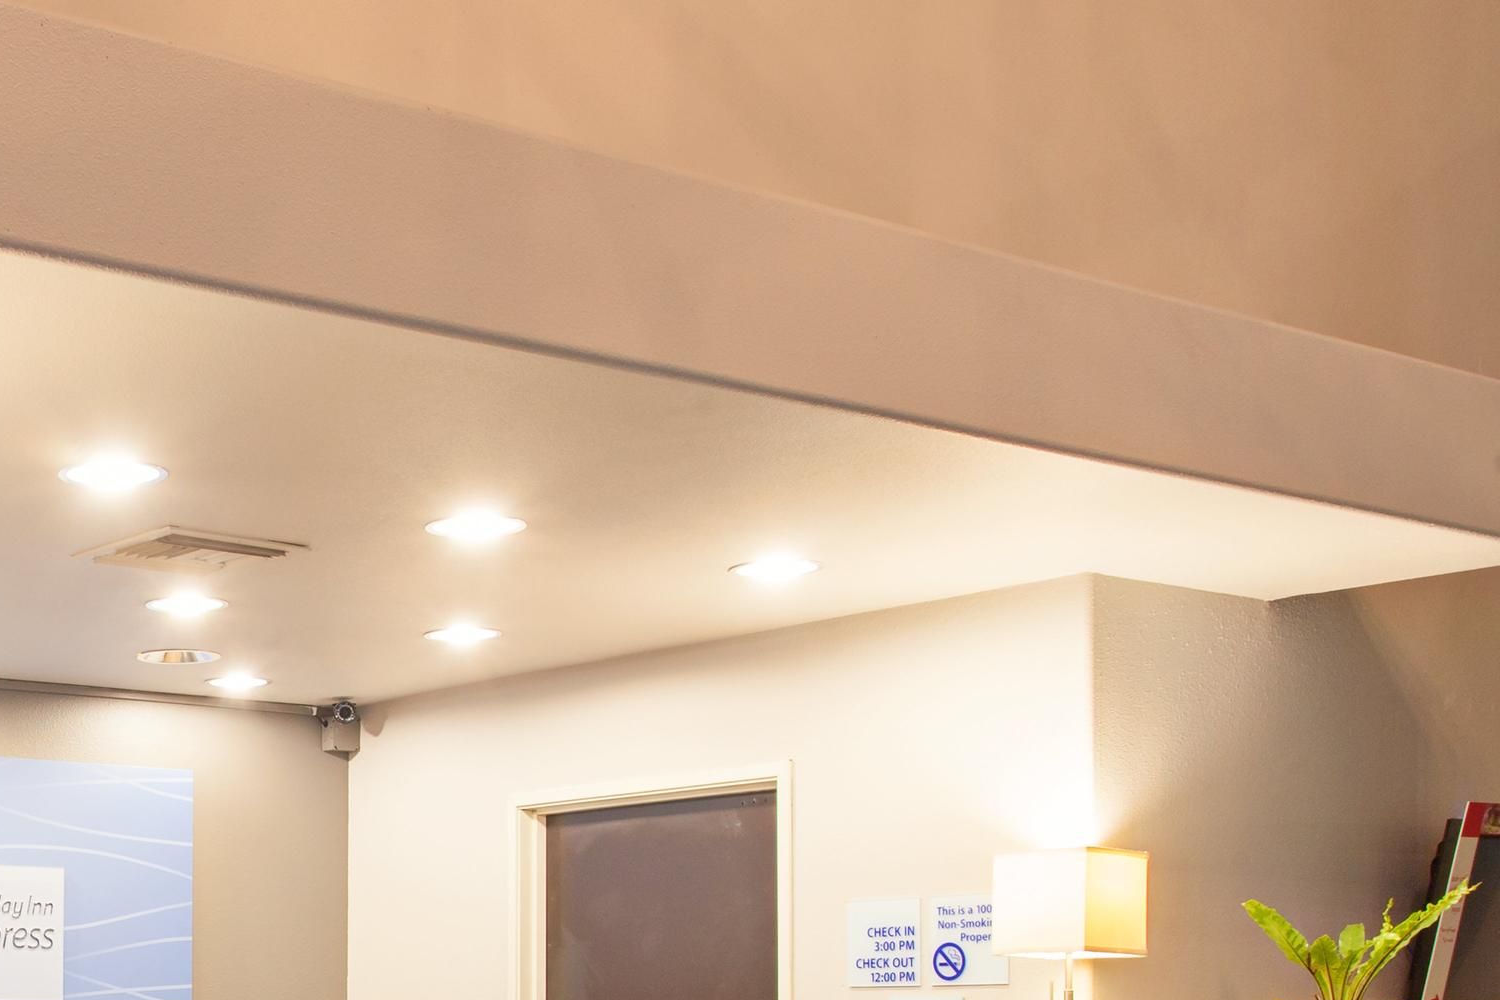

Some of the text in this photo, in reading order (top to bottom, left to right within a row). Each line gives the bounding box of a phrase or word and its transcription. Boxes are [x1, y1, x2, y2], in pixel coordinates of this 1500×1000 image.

[26, 895, 54, 916] Inn
[937, 906, 955, 915] This
[958, 905, 965, 915] is
[977, 904, 992, 914] 100
[937, 918, 992, 929] Non-Smoki
[867, 926, 915, 938] CHECK IN
[960, 933, 991, 942] Proper
[874, 940, 915, 951] 3:00 PM
[856, 957, 914, 969] CHECK OUT
[871, 971, 915, 983] 12:00 PM
